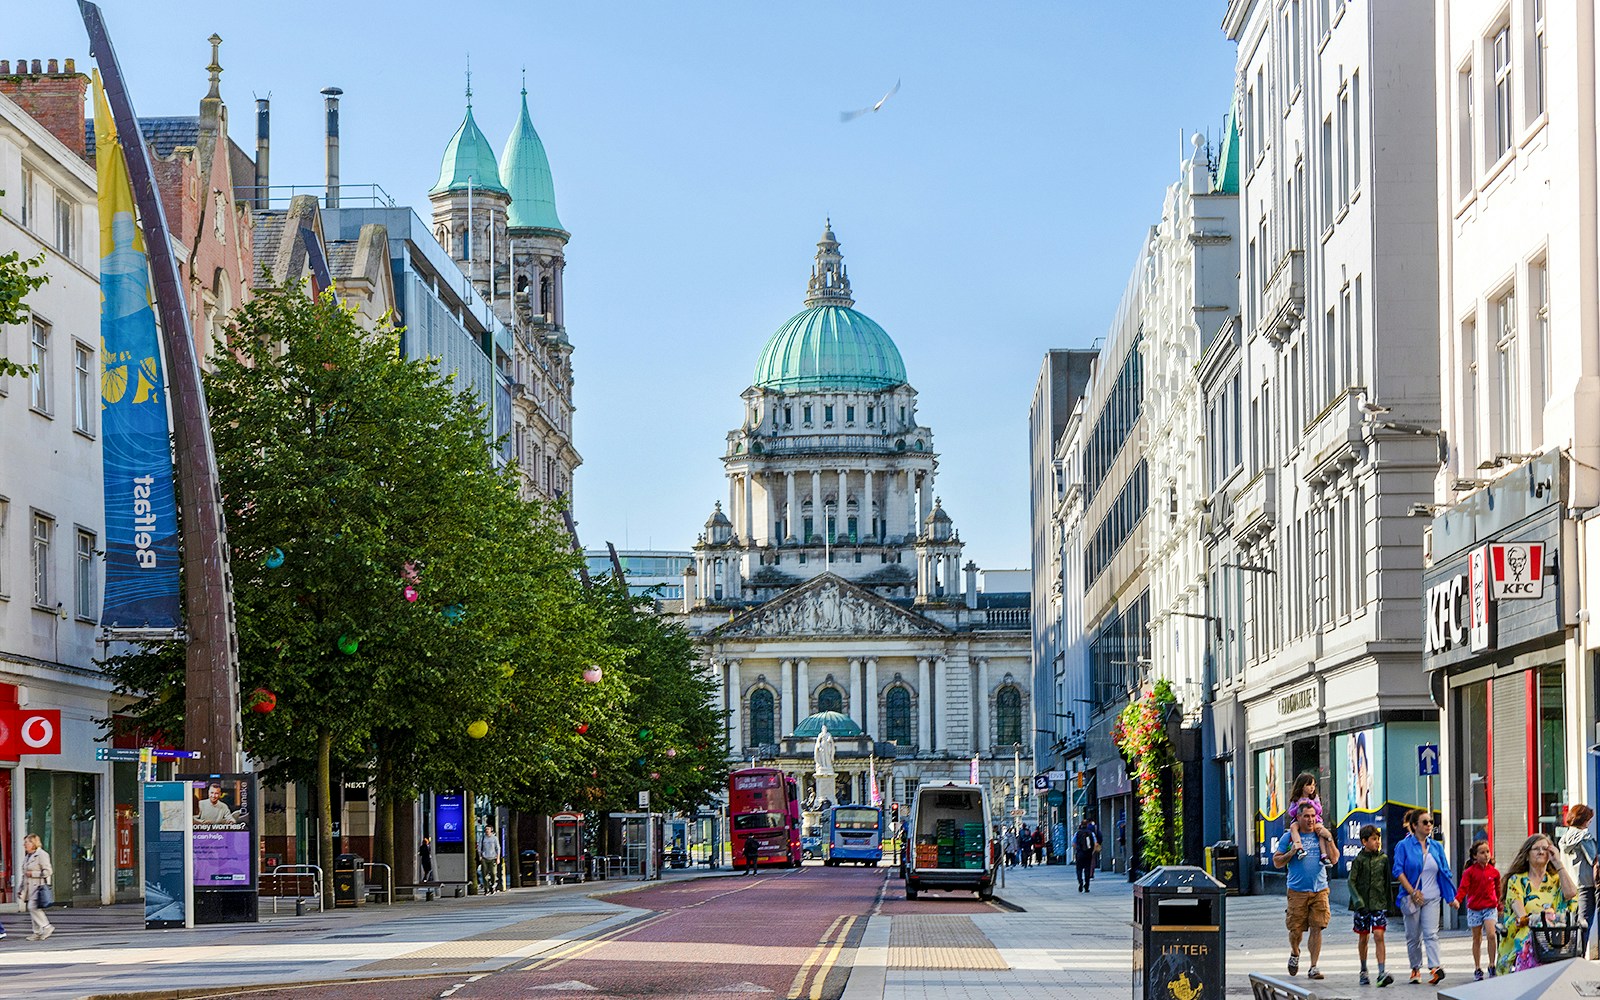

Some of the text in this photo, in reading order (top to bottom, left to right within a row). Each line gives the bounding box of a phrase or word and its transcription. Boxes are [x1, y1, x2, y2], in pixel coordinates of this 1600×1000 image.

[1503, 583, 1534, 594] KFC
[1425, 574, 1463, 653] KFC
[212, 822, 246, 830] worries?
[121, 829, 129, 845] TO
[120, 848, 130, 864] LET
[1162, 944, 1208, 956] LITTER
